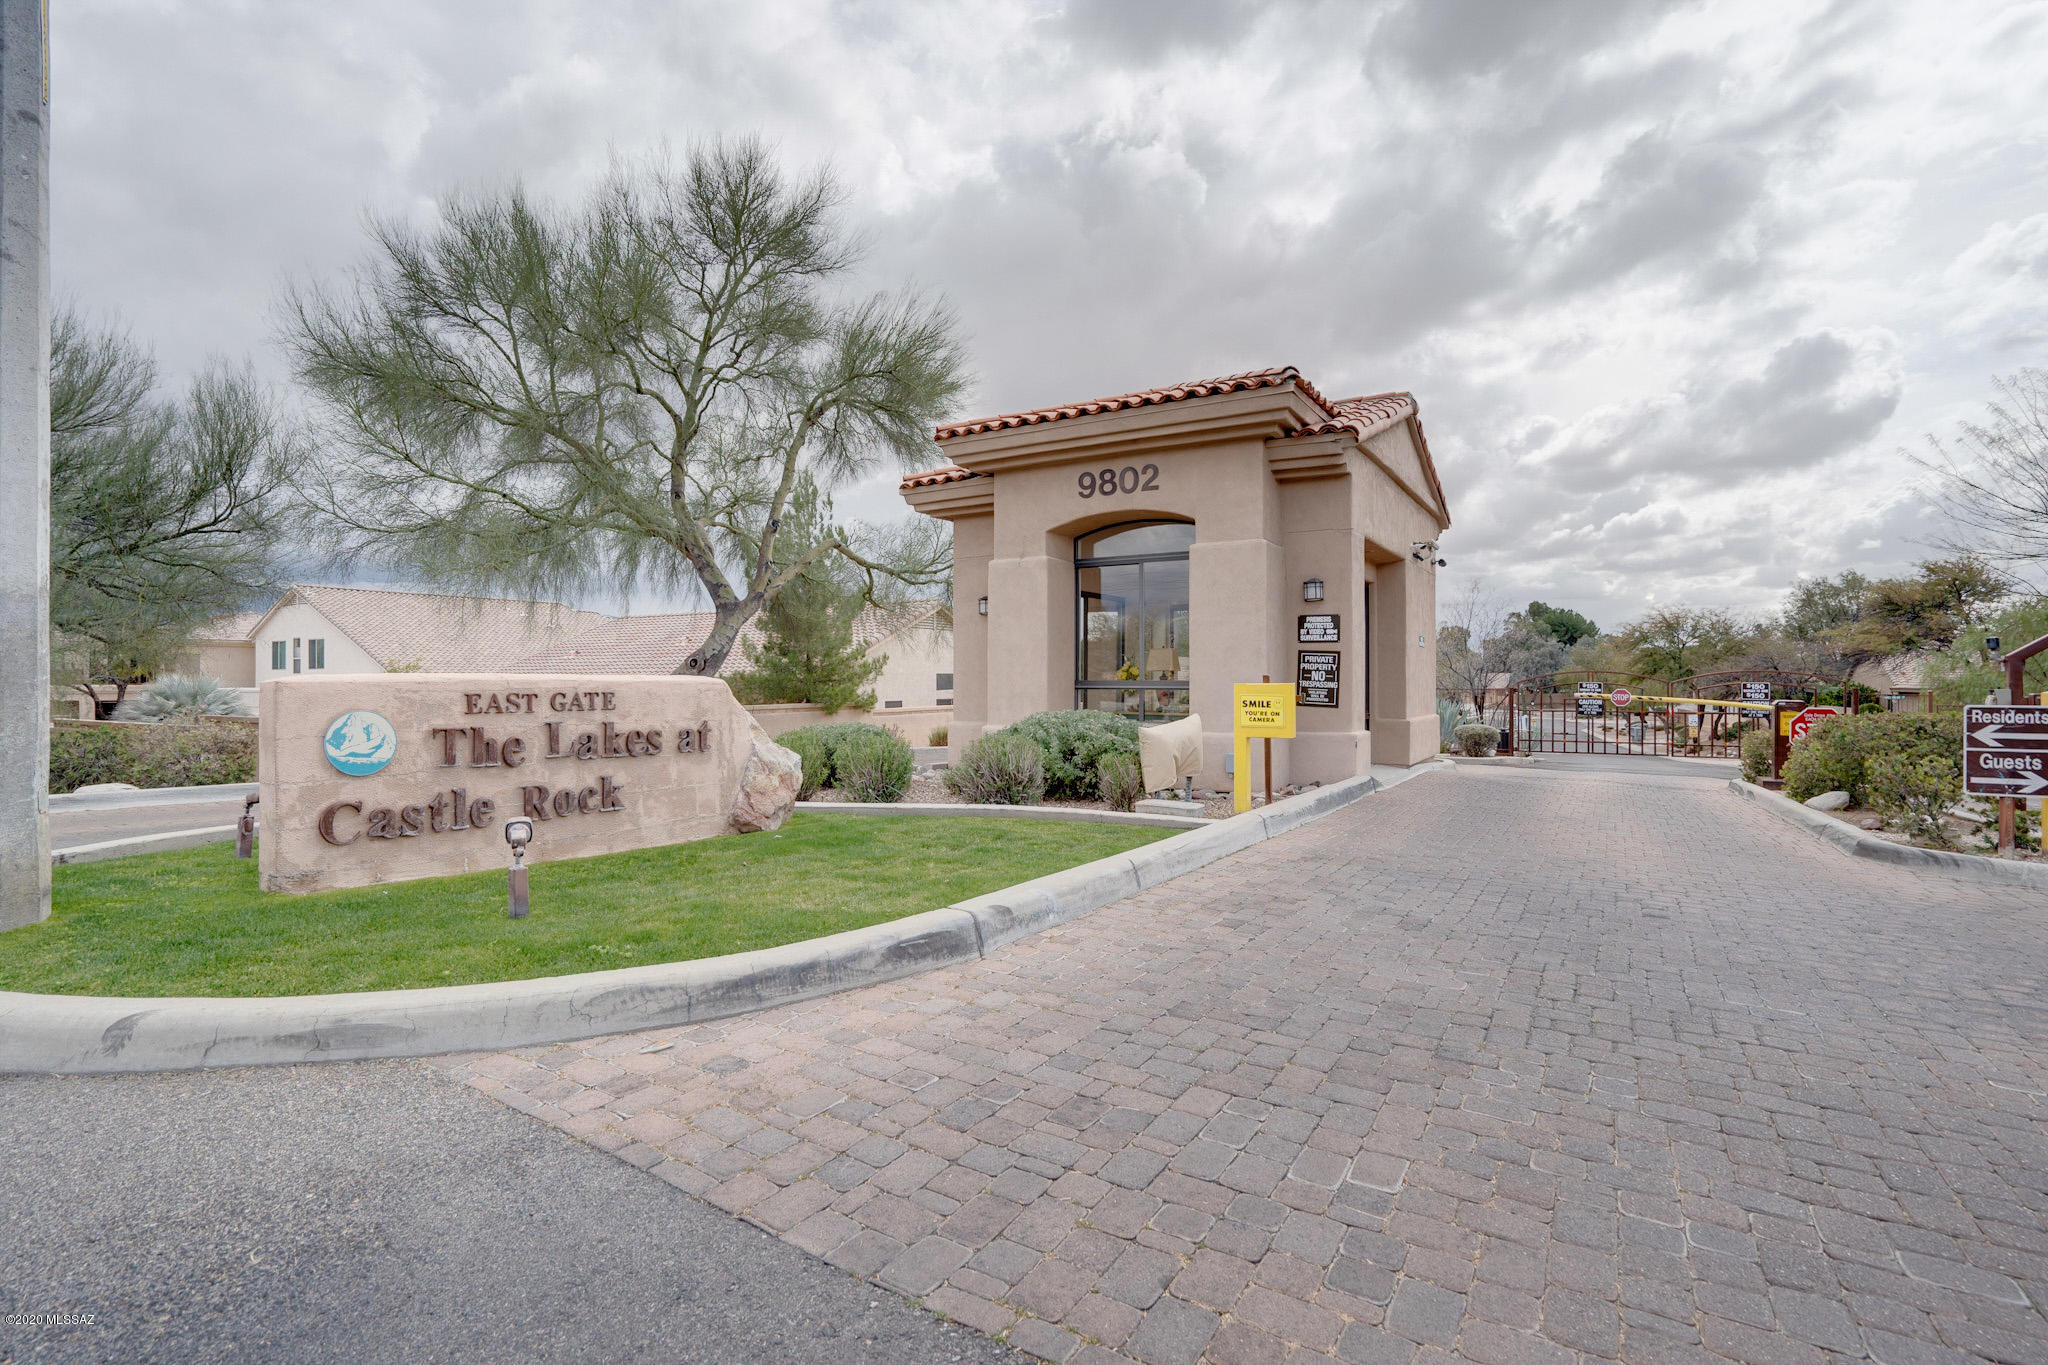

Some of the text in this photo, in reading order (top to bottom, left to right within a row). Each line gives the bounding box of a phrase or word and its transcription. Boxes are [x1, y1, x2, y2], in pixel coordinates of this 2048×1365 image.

[1078, 463, 1159, 499] 9802
[1299, 680, 1339, 688] TRESPASSING
[1311, 670, 1326, 681] NO
[464, 692, 616, 715] EAST GATE
[1242, 700, 1272, 708] SMILE
[1972, 709, 2048, 724] Residents
[432, 719, 712, 768] The Lakes at
[1979, 753, 2042, 771] Guests
[318, 775, 626, 846] Castle Rock
